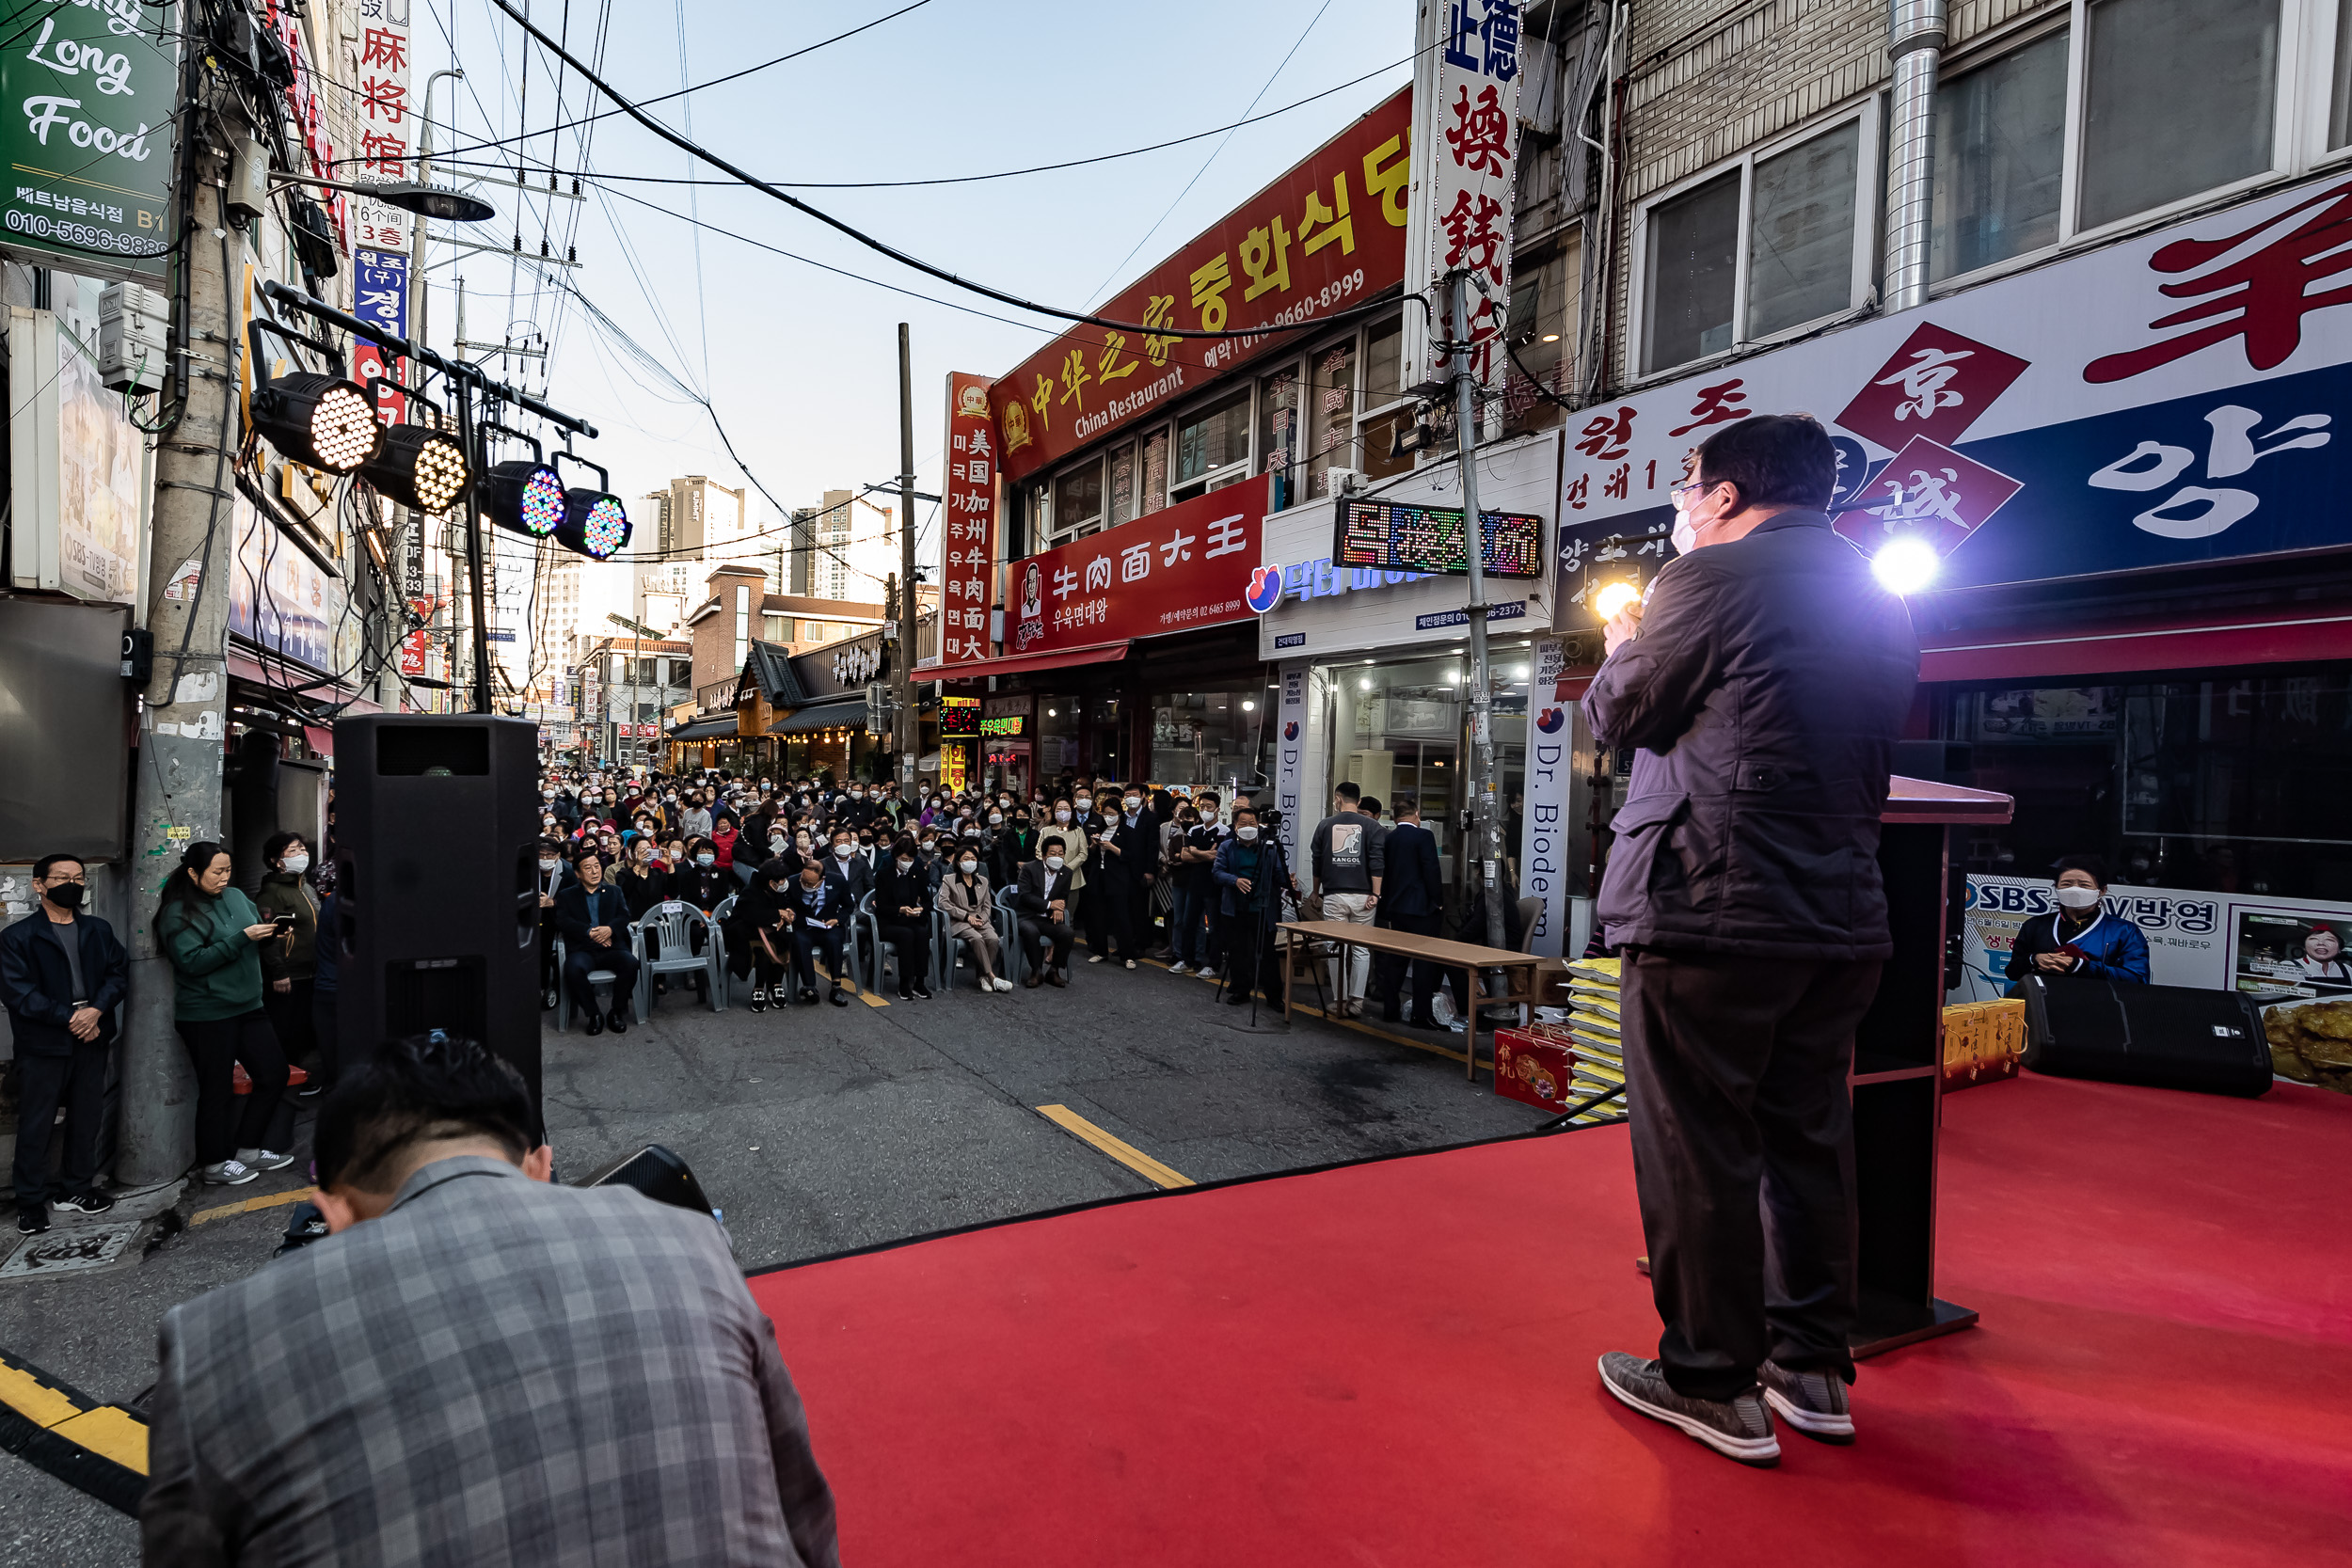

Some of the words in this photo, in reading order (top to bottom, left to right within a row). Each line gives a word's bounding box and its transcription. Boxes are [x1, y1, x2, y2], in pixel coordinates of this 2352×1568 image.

[26, 16, 135, 96] Long
[23, 95, 151, 162] Food
[16, 185, 123, 223] 베트남음식점
[136, 209, 164, 231] B1
[364, 269, 402, 287] (구)
[1075, 410, 1108, 438] China
[1108, 366, 1184, 421] Restaurant
[2088, 404, 2332, 540] 양
[1053, 514, 1248, 601] 牛肉面大王
[1053, 597, 1108, 632] 우육면대왕
[1200, 605, 1208, 617] 02
[1209, 603, 1223, 616] 6465
[1224, 600, 1241, 612] 8999
[1282, 749, 1298, 784] Dr.
[1534, 744, 1562, 789] Dr.
